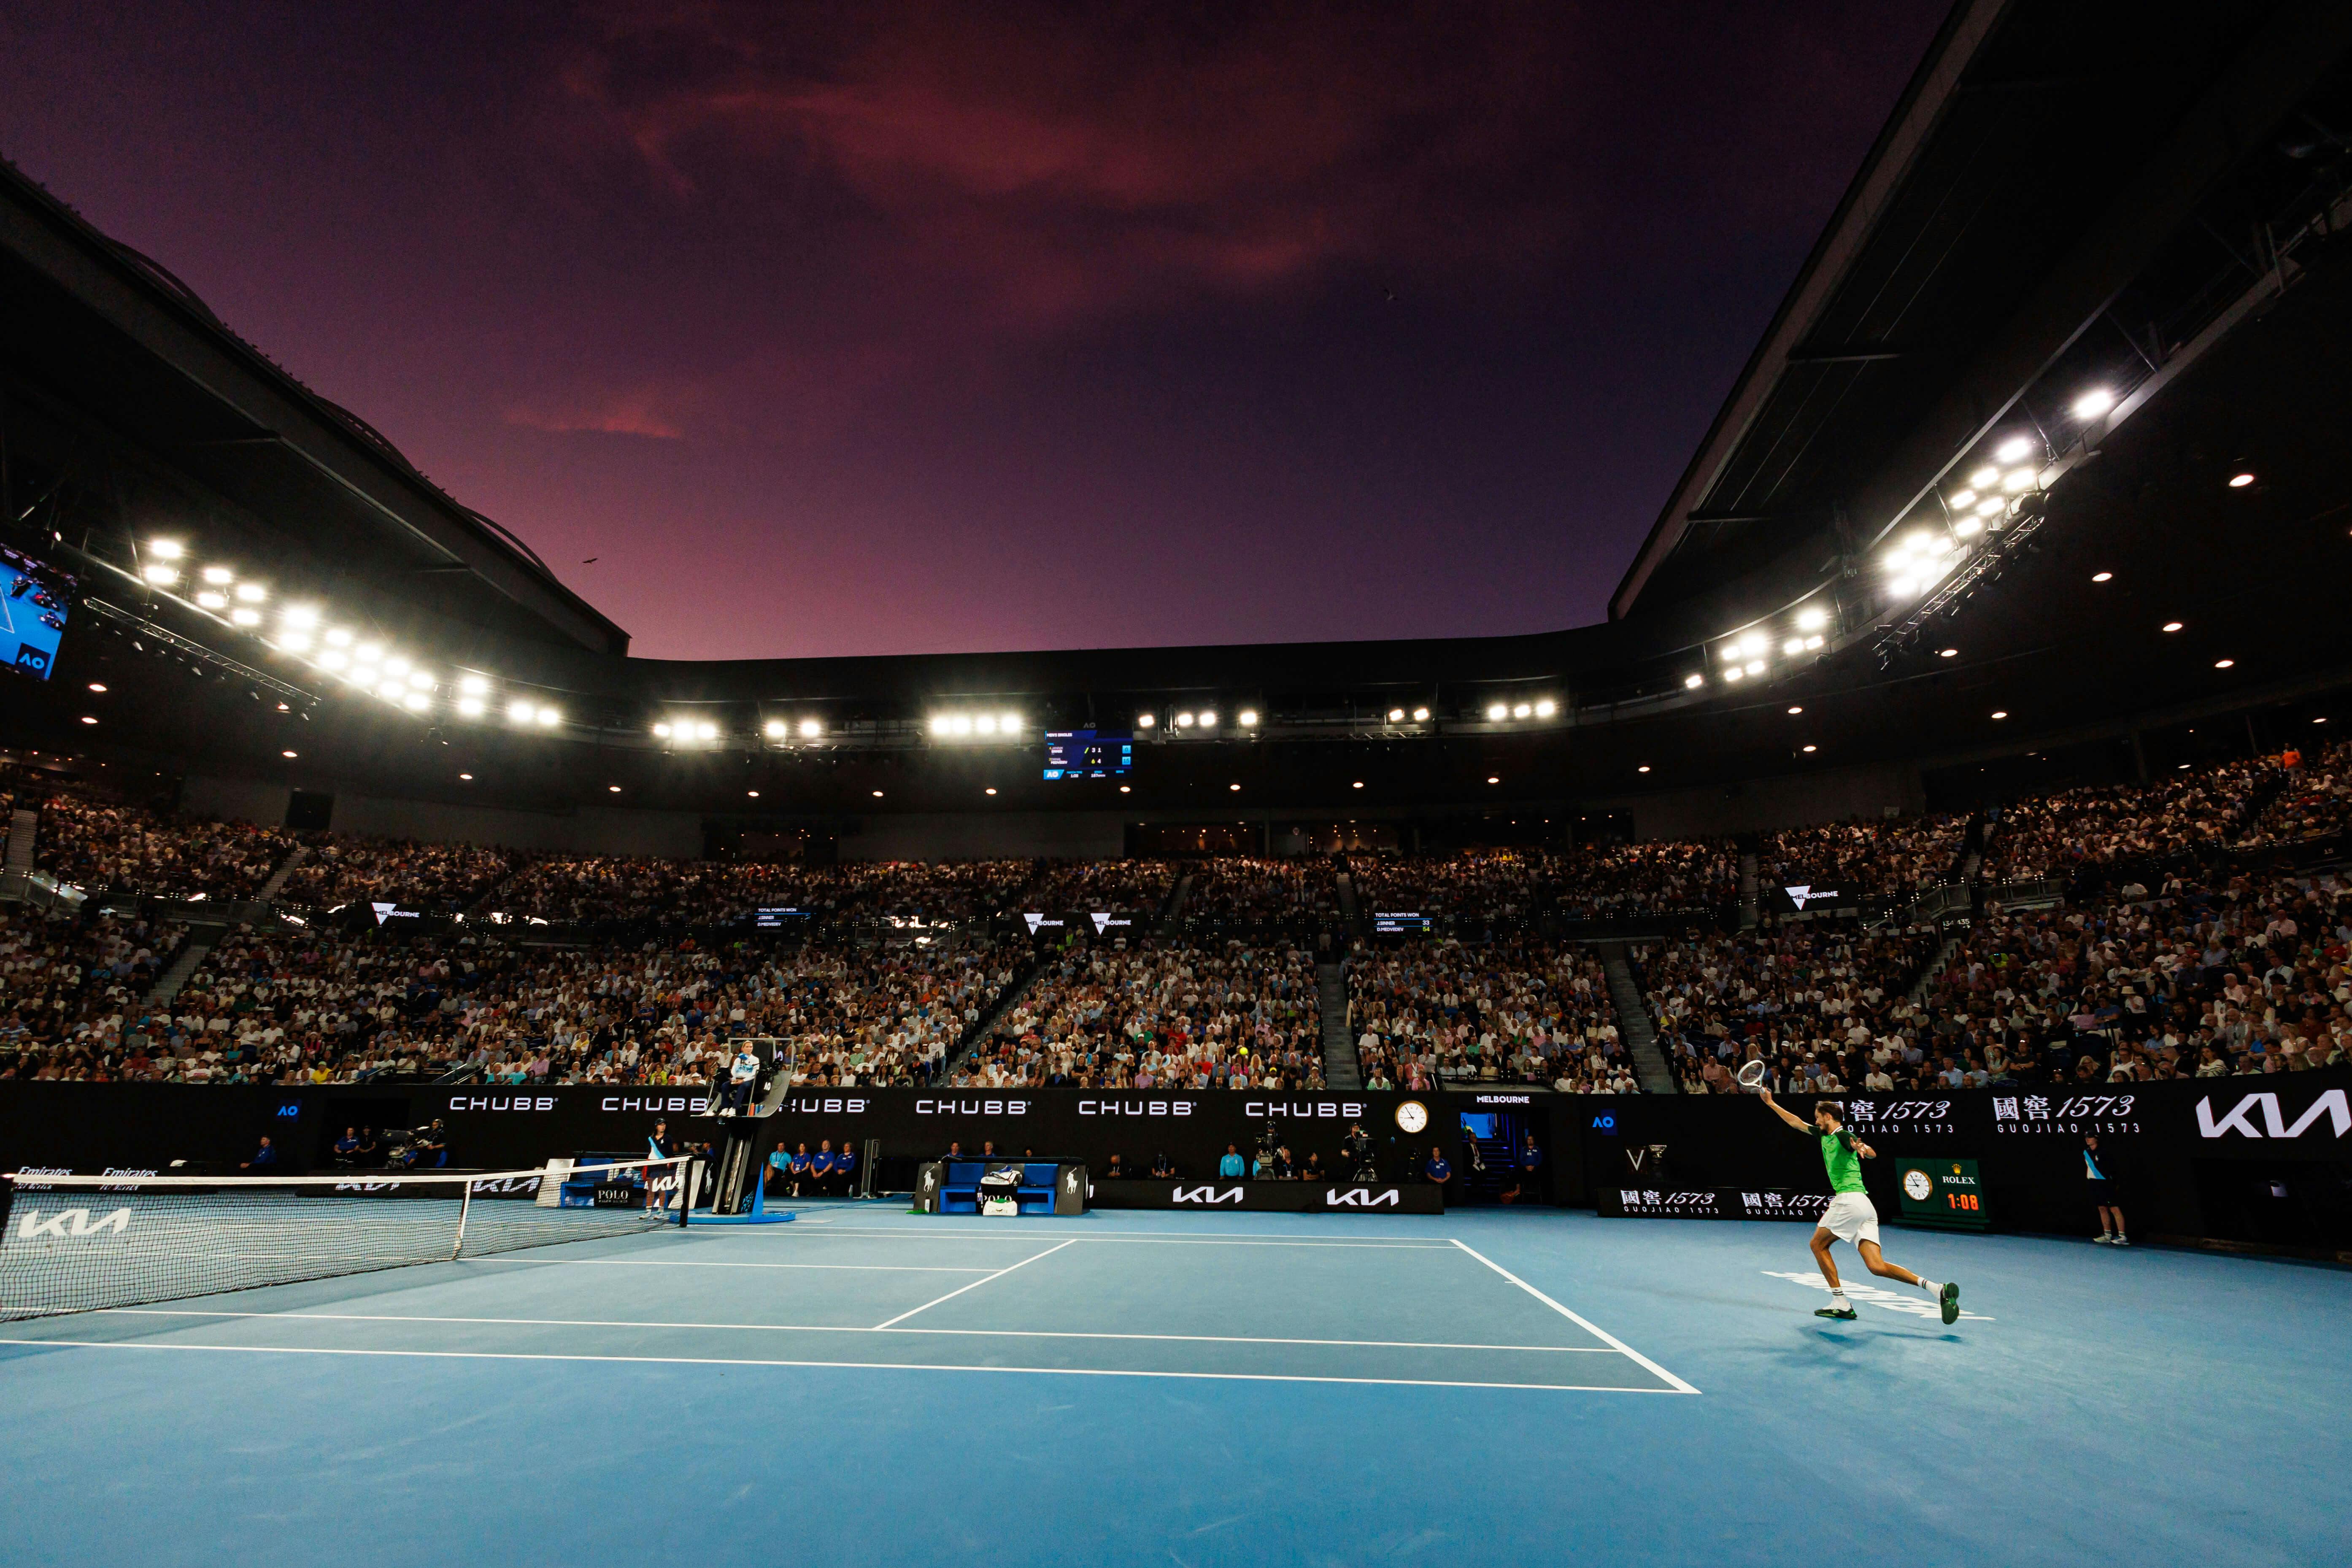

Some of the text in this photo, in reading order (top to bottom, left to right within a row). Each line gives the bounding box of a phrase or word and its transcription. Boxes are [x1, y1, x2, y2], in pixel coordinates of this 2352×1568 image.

[19, 653, 44, 669] AO
[1477, 1096, 1529, 1104] MELBOURNE
[2056, 1096, 2134, 1117] 1573
[277, 1105, 298, 1116] AO
[1880, 1101, 1950, 1119] 1573
[2196, 1090, 2352, 1138] KIA
[1593, 1117, 1614, 1128] AO
[1914, 1125, 1953, 1133] 1573
[1998, 1123, 2139, 1133] GUOJIAO 1573
[1627, 1149, 1644, 1171] V
[1942, 1176, 1976, 1184] ROLEX
[598, 1190, 628, 1200] POLO
[1173, 1186, 1243, 1203] KIA
[1327, 1188, 1399, 1206] KIA
[1664, 1192, 1715, 1204] 1573
[1947, 1193, 1979, 1210] 1:08
[18, 1208, 132, 1238] KIA
